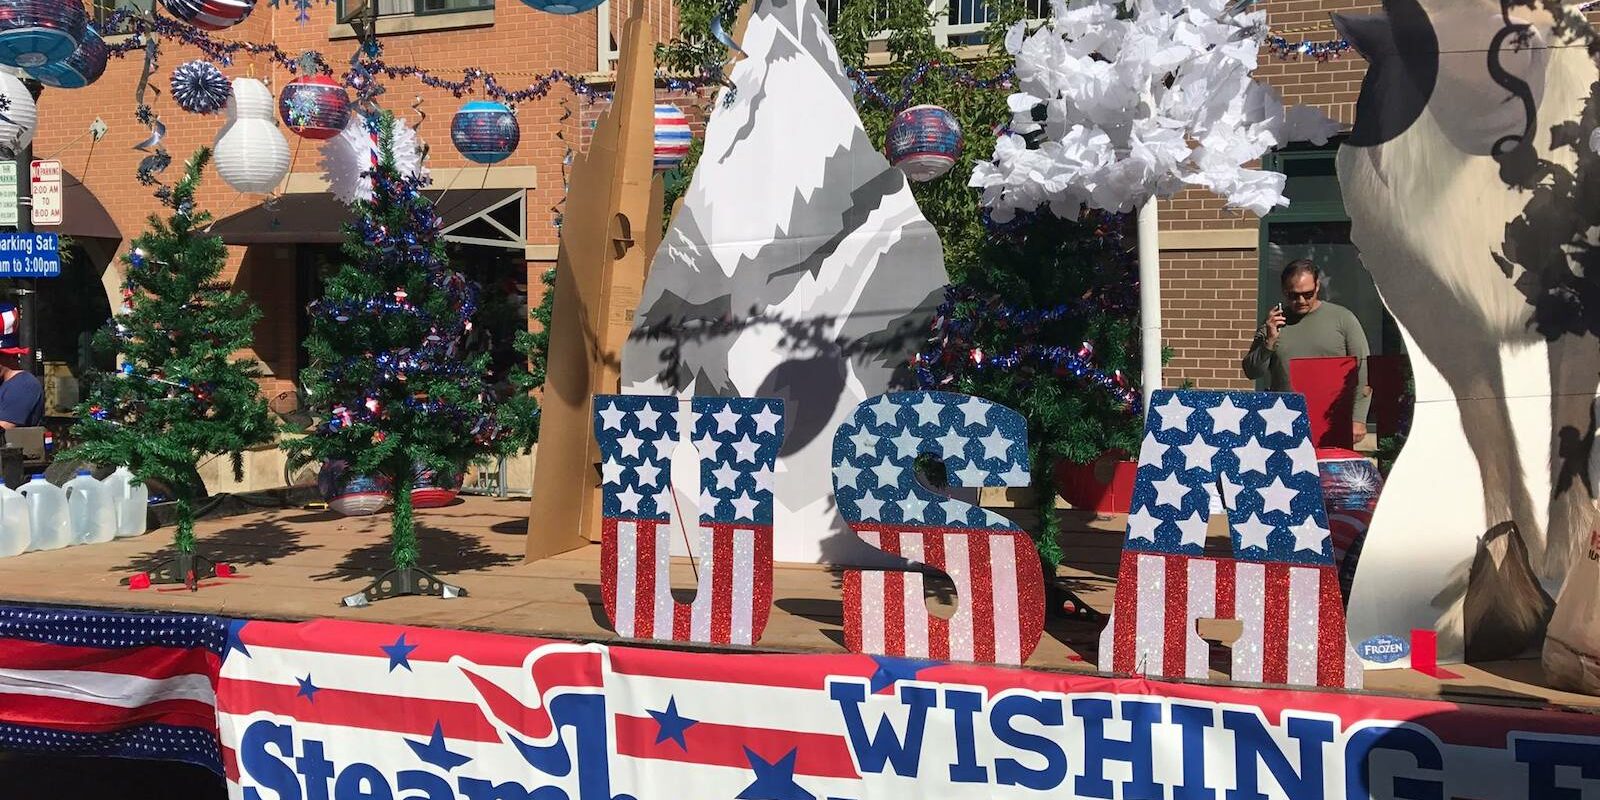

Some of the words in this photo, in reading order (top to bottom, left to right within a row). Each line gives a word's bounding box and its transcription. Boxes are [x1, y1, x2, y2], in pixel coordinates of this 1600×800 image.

[33, 186, 47, 194] 2:00
[42, 197, 50, 205] TO
[35, 209, 48, 217] 8:00
[0, 235, 32, 254] arking
[36, 235, 55, 250] Sat.
[13, 258, 22, 272] to
[25, 257, 57, 276] 3:00pm
[594, 390, 1364, 689] USA
[1364, 642, 1402, 655] FROZEN
[830, 681, 1443, 800] WISHING
